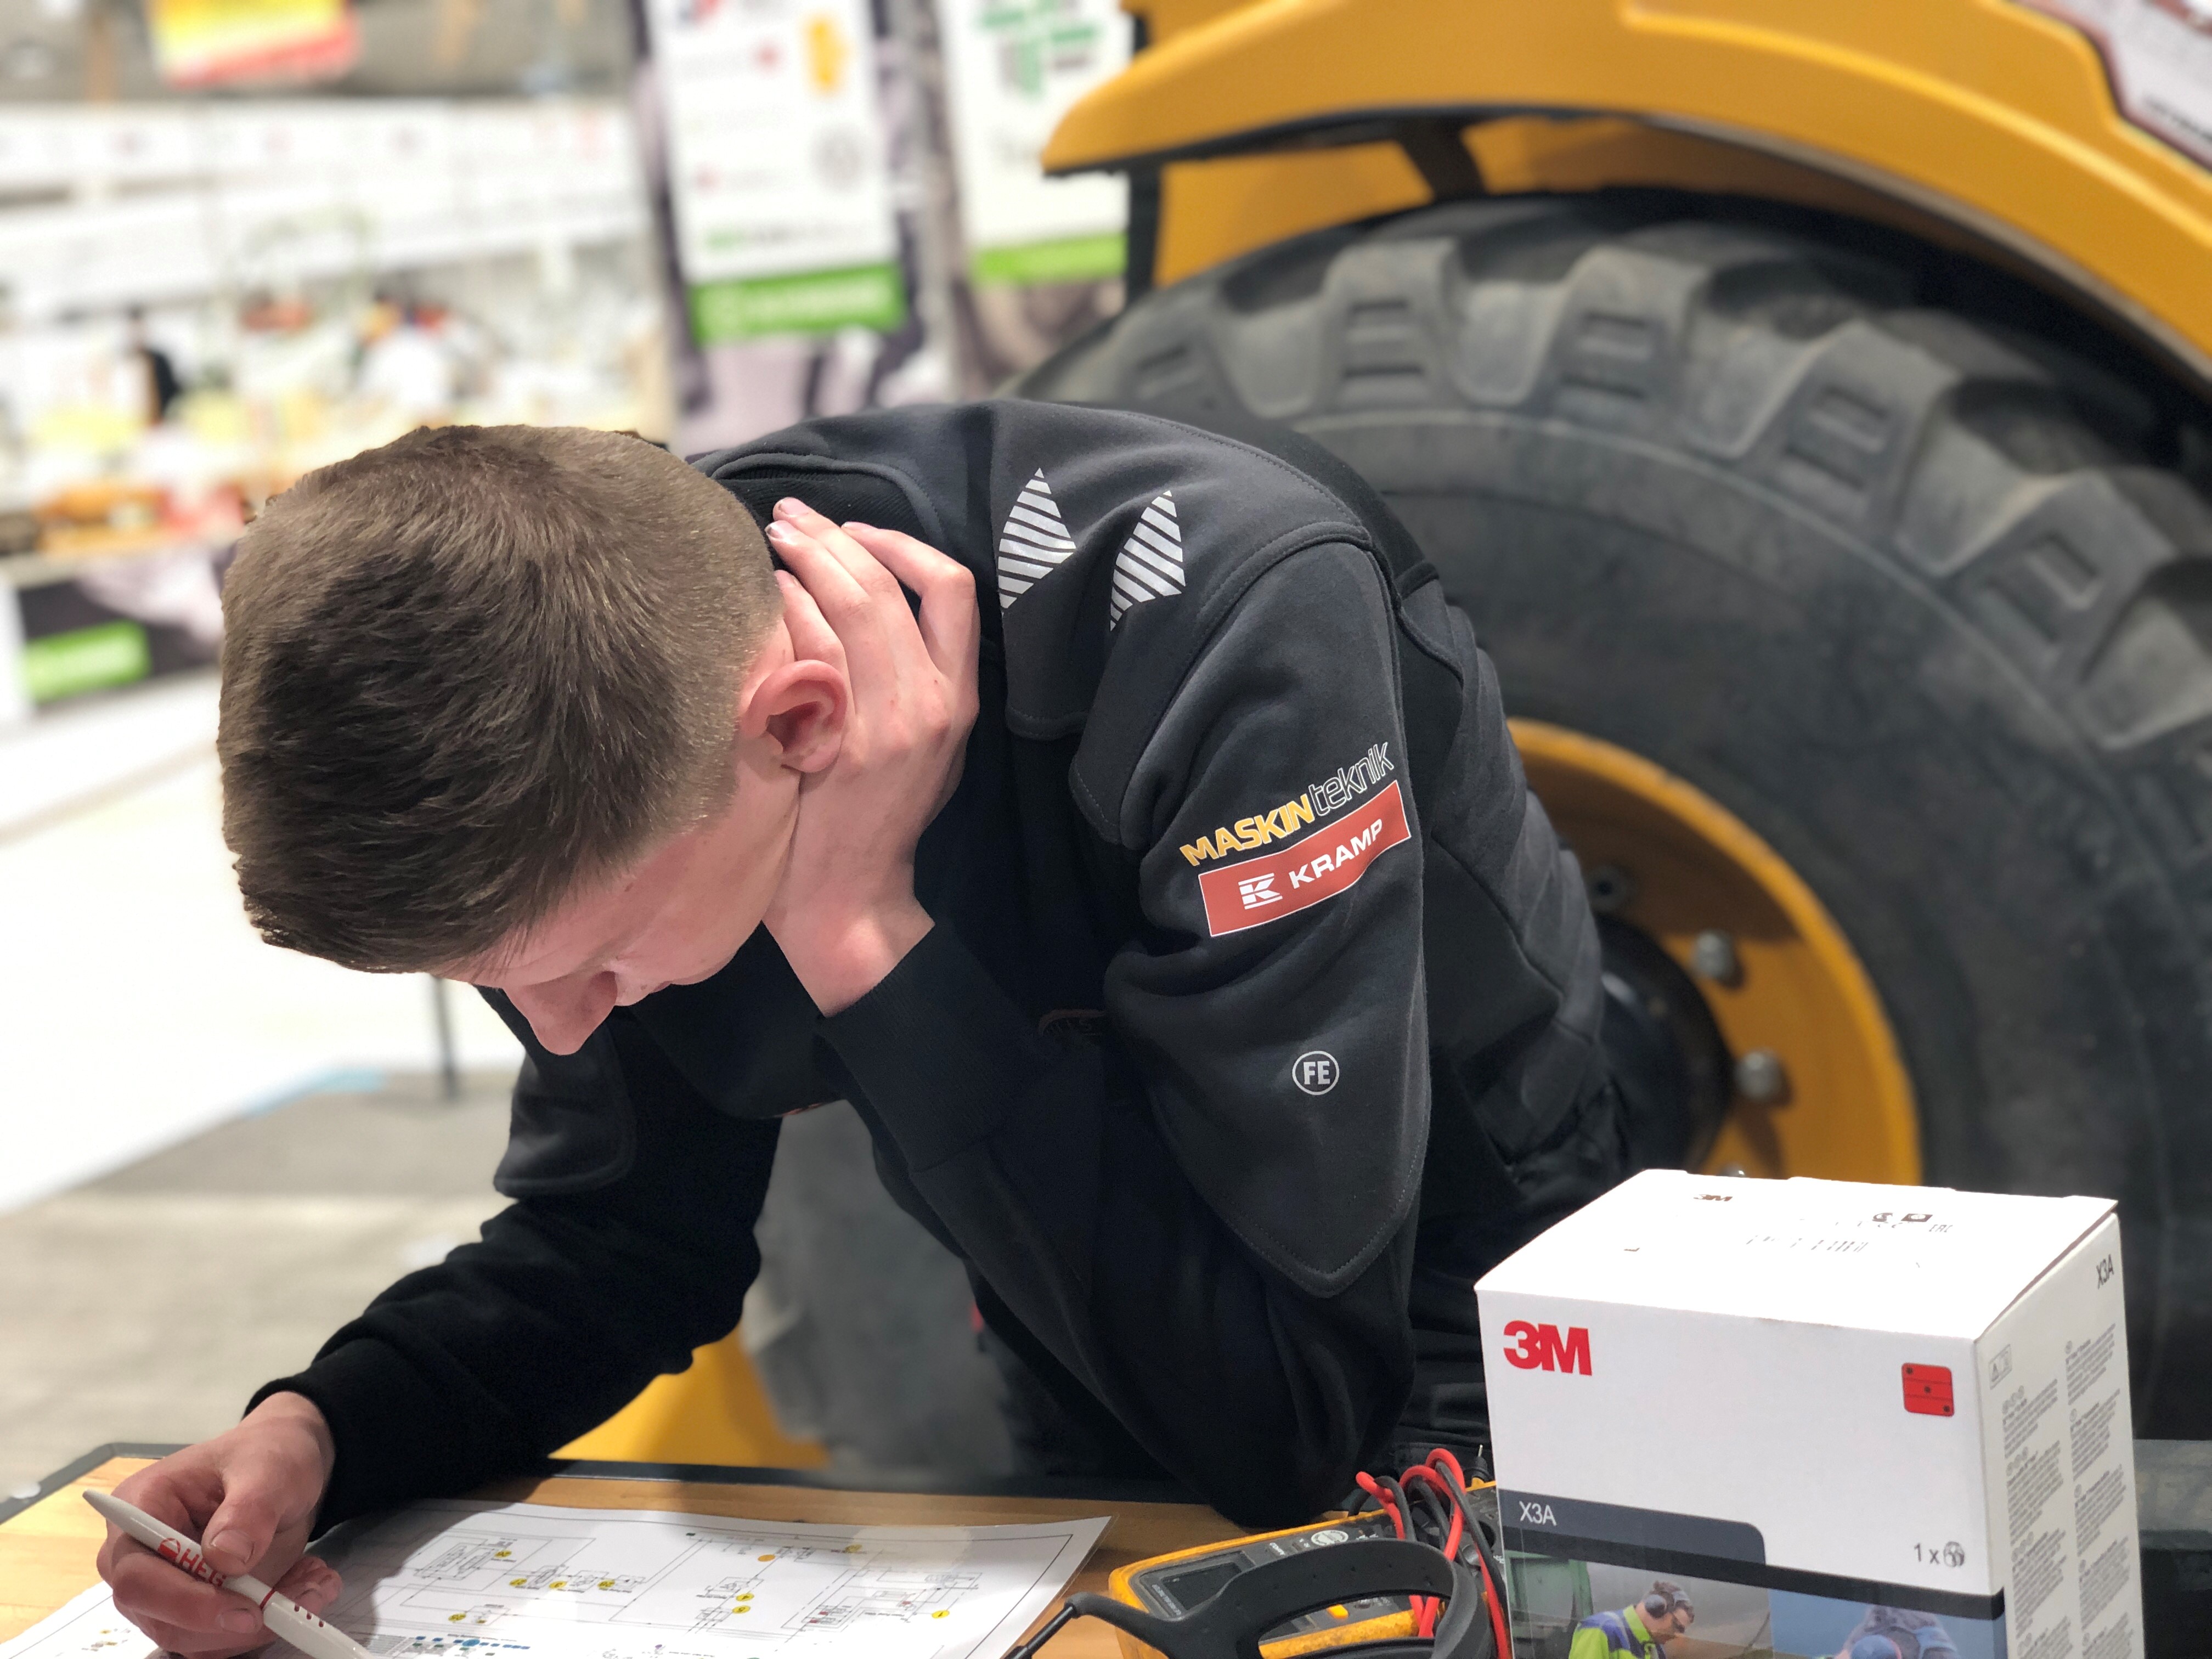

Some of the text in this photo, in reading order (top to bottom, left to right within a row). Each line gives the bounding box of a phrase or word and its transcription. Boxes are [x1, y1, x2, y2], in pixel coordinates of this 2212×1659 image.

[1288, 818, 1383, 889] KRAMP
[1303, 1060, 1330, 1085] FE
[2096, 1254, 2114, 1290] X3A
[1503, 1319, 1593, 1376] 3M
[1519, 1500, 1557, 1526] X3A
[1914, 1542, 1922, 1562] 1
